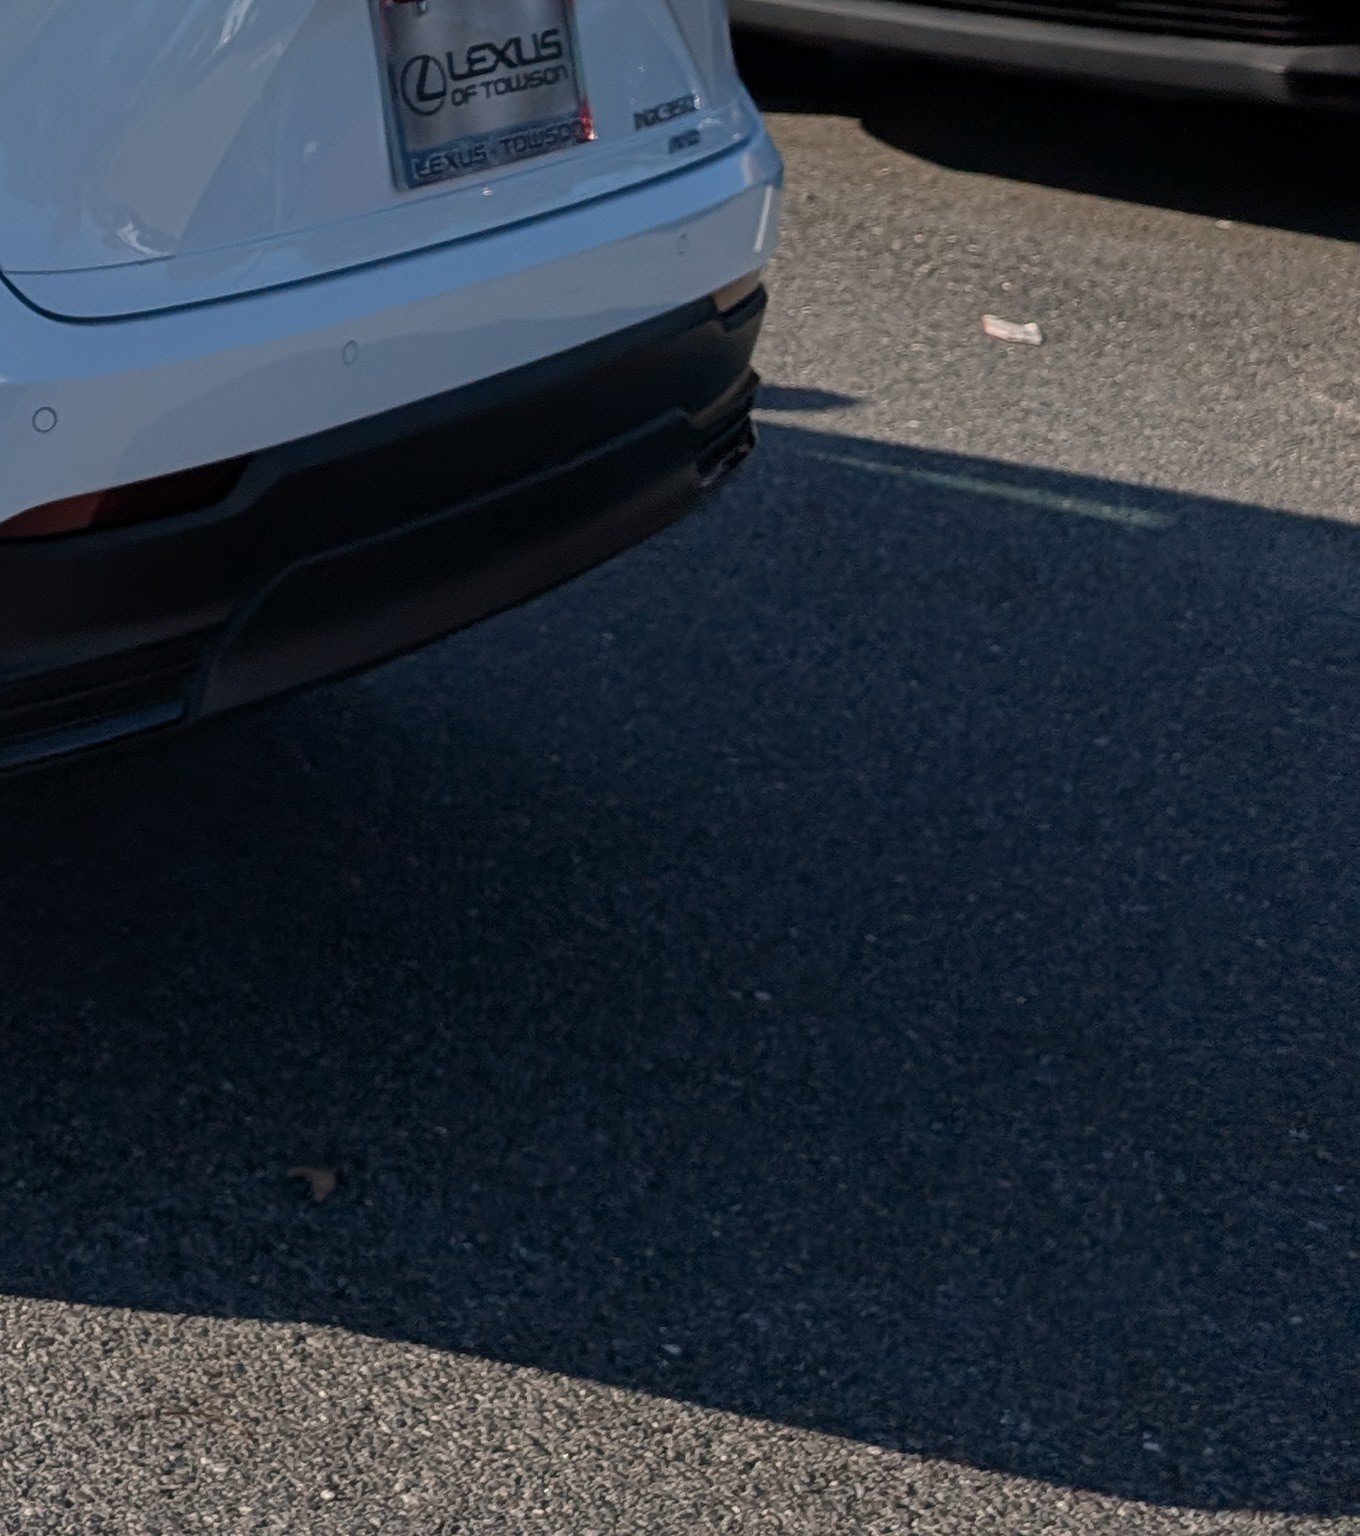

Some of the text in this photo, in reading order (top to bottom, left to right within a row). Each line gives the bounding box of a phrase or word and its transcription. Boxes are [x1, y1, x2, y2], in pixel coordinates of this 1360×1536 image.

[446, 28, 563, 82] LEXUS
[451, 64, 569, 106] OF TOWSON
[414, 144, 488, 179] LEXUS
